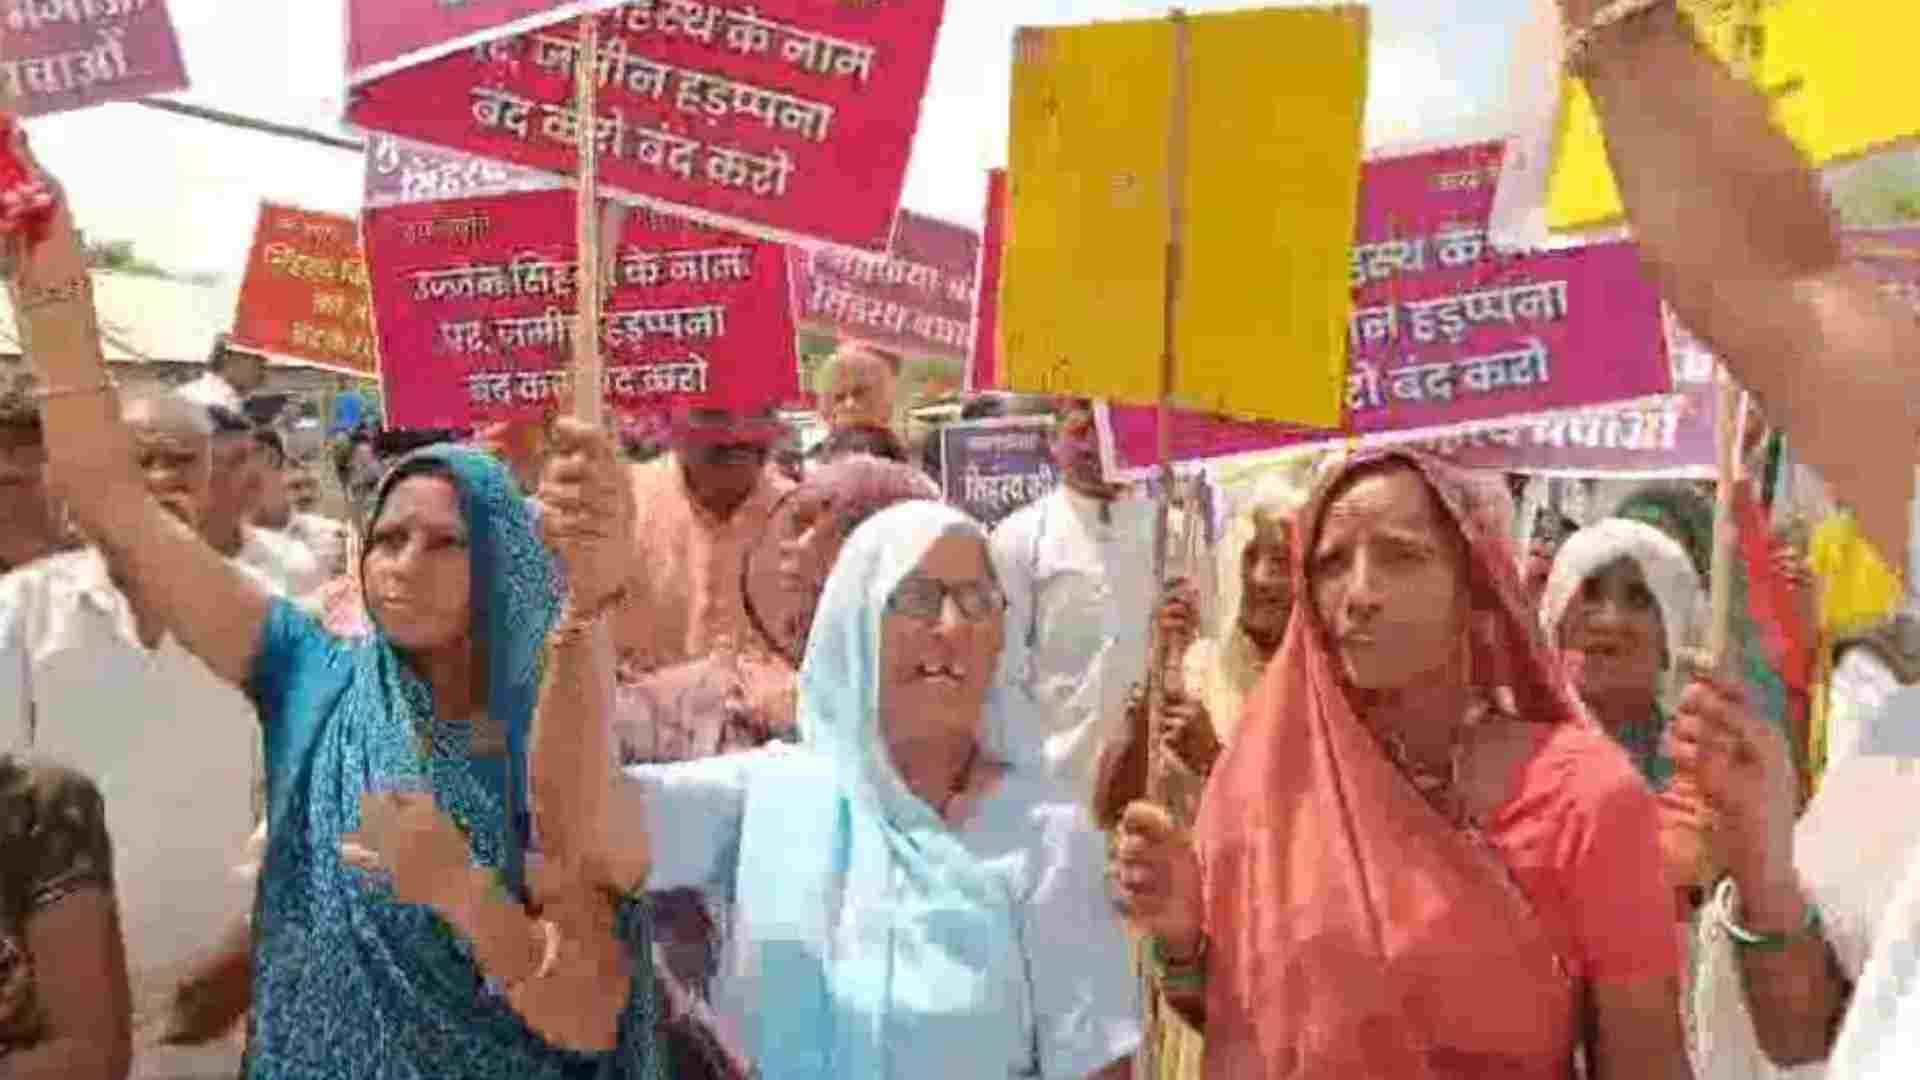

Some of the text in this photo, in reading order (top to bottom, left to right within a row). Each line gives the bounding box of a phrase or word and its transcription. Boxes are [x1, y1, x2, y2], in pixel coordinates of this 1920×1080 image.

[725, 6, 771, 54] के
[781, 35, 876, 82] नाम
[470, 84, 532, 138] बंद
[636, 120, 700, 178] बंद
[704, 144, 794, 197] करो
[623, 248, 662, 288] के
[1388, 353, 1456, 402] बंद
[1460, 340, 1550, 388] करो
